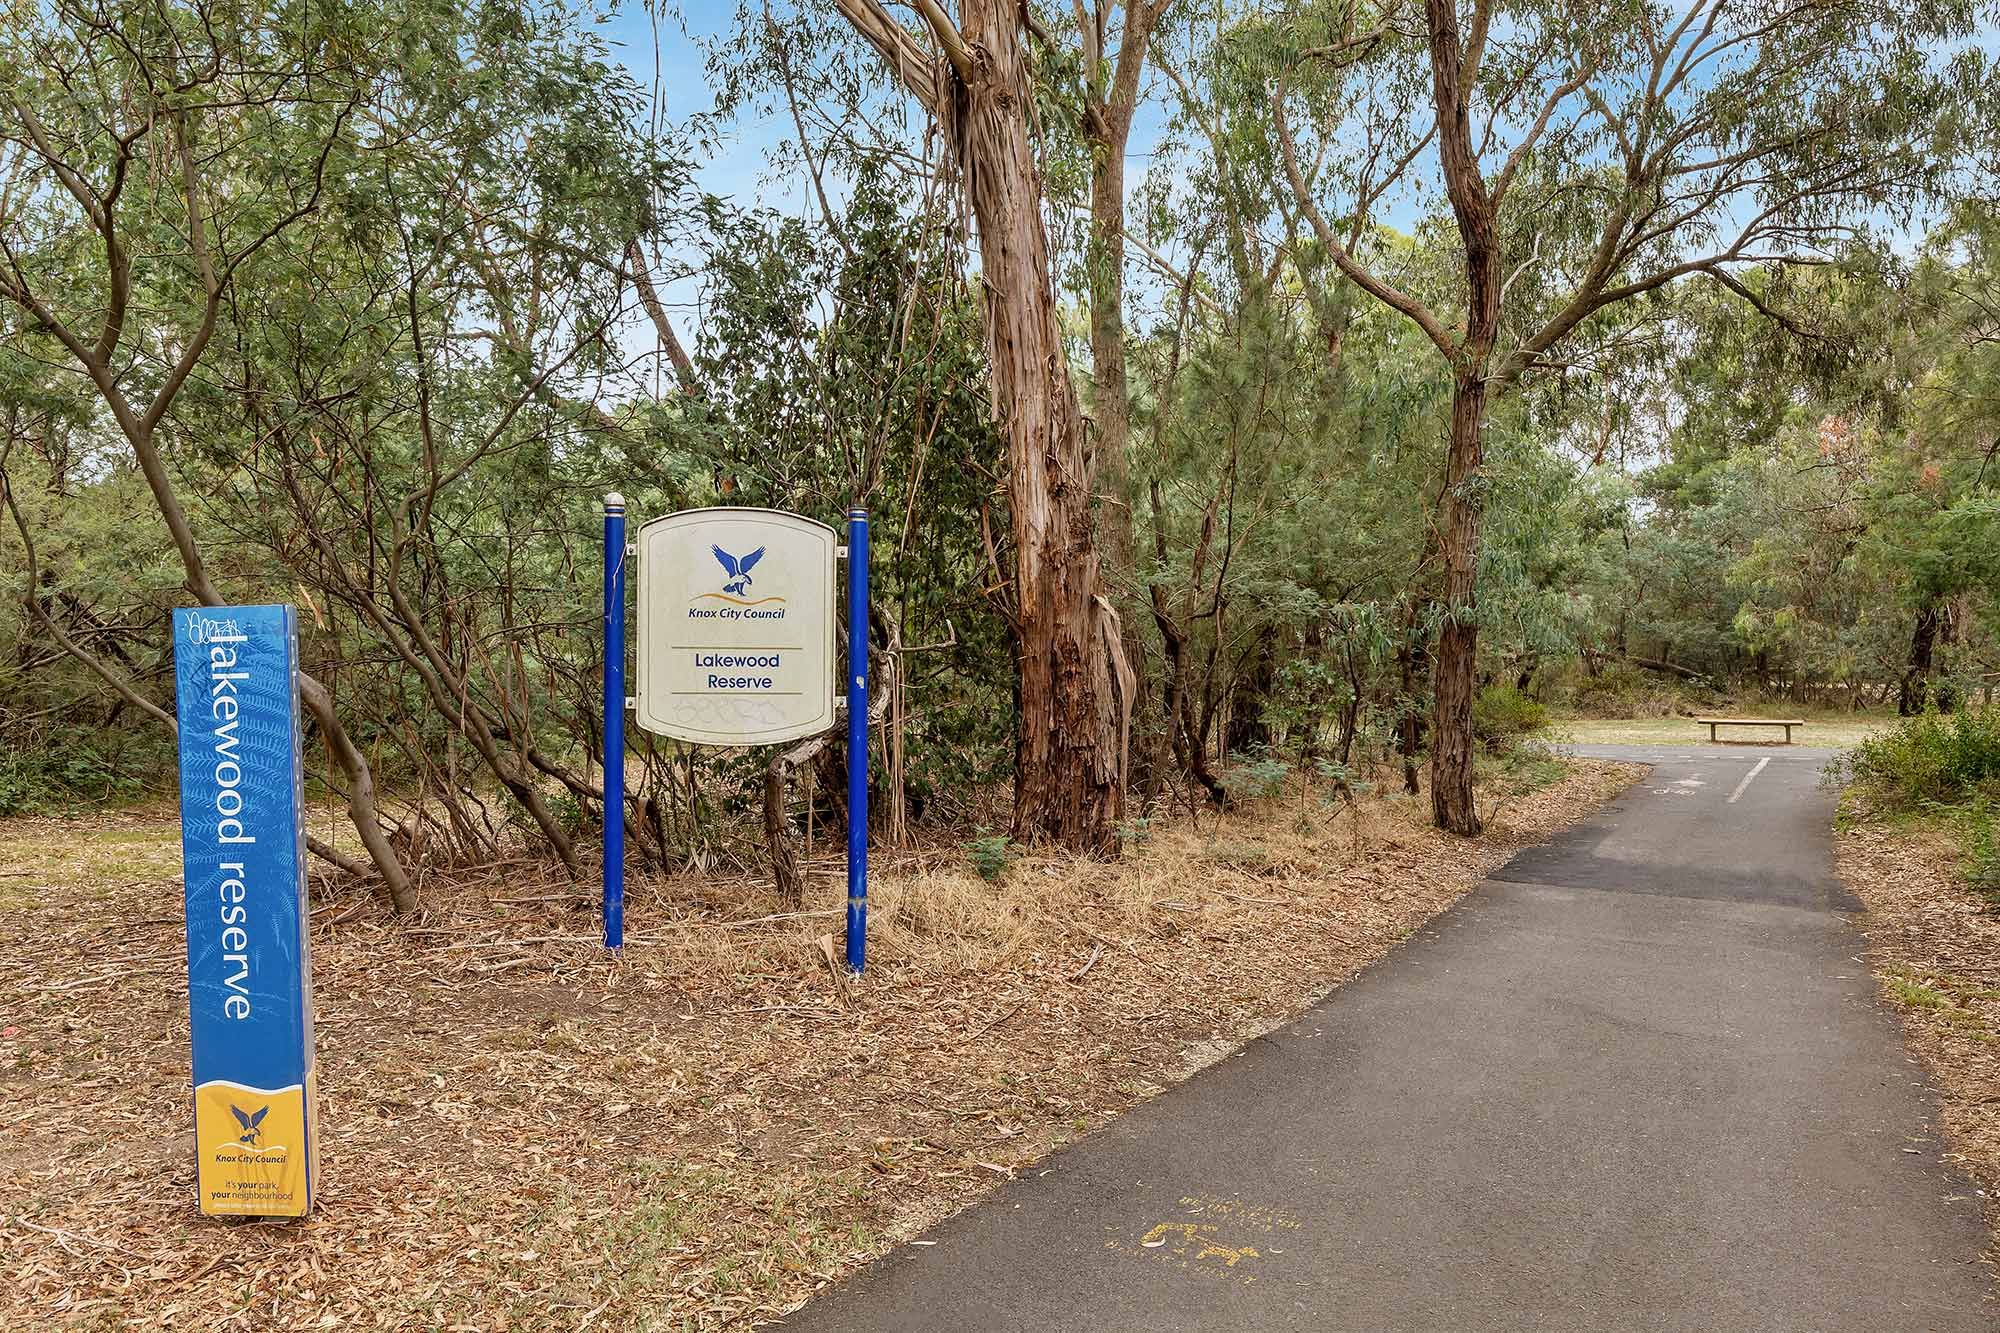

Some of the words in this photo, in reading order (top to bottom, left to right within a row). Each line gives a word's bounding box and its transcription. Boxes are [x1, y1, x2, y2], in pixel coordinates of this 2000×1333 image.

[688, 608, 717, 618] Knox
[719, 608, 741, 620] City
[743, 608, 785, 619] Council
[695, 653, 780, 667] Lakewood
[708, 674, 772, 688] Reserve
[210, 635, 256, 844] lakewood
[219, 862, 251, 1020] reserve
[215, 1154, 236, 1163] Knox
[237, 1154, 254, 1164] City
[255, 1154, 287, 1163] Council
[238, 1182, 257, 1190] your
[211, 1191, 231, 1200] your
[232, 1191, 294, 1201] neighbourhood
